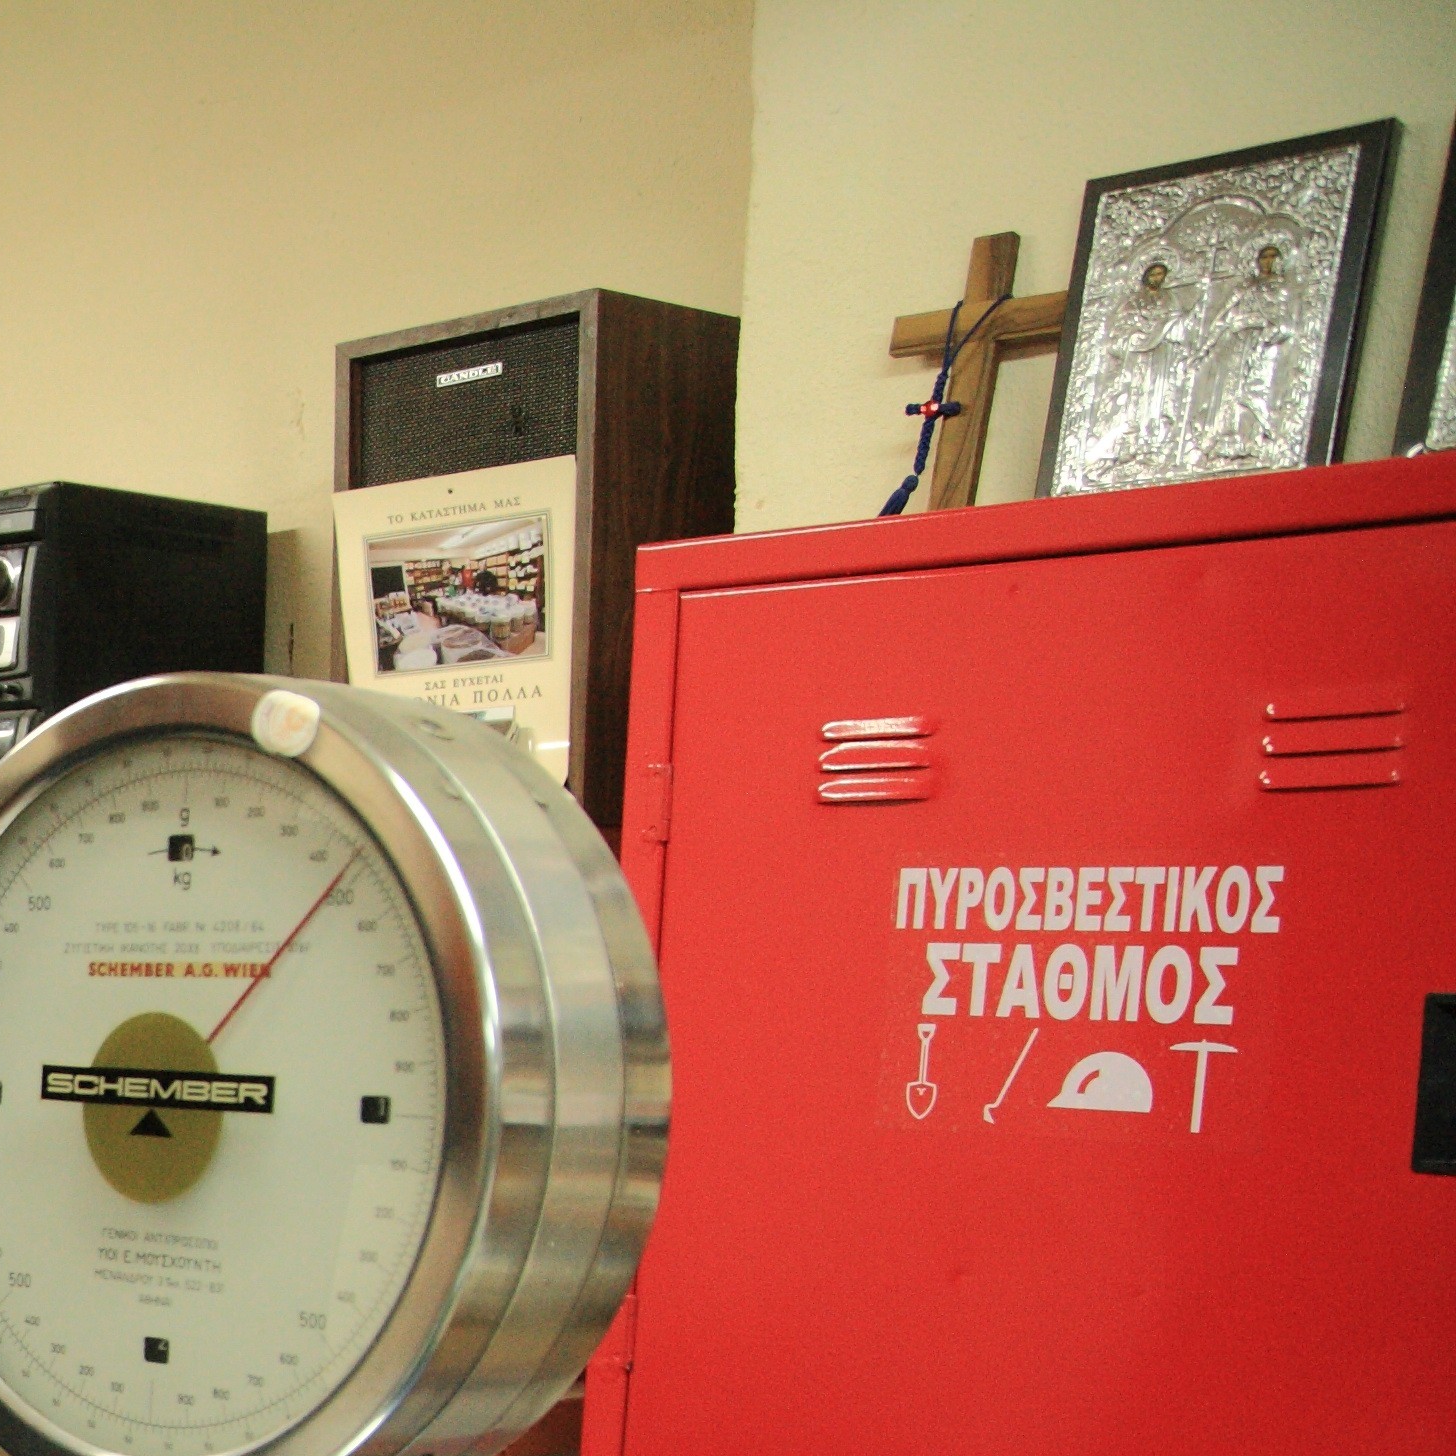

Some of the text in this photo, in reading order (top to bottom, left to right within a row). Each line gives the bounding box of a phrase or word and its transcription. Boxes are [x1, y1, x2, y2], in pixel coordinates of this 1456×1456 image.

[387, 496, 521, 525] ΤΟ ΚΑΤΑΣΤΗΜΑ ΜΑΣ
[424, 674, 504, 691] ΣΑΣ ΕΥΧΕΤΑΙ
[472, 684, 543, 704] ΠΟΛΛΑ
[173, 869, 192, 890] kg
[28, 896, 52, 912] 500
[895, 865, 1285, 934] ΠΥΡΟΣΒΕΣΤΙΚΟΣ
[88, 961, 175, 978] SCHEMBER
[920, 942, 1240, 1026] ΣΤΑΘΜΟΣ
[46, 1071, 269, 1105] SCHEMBER
[8, 1271, 33, 1288] 500
[299, 1310, 327, 1331] 500
